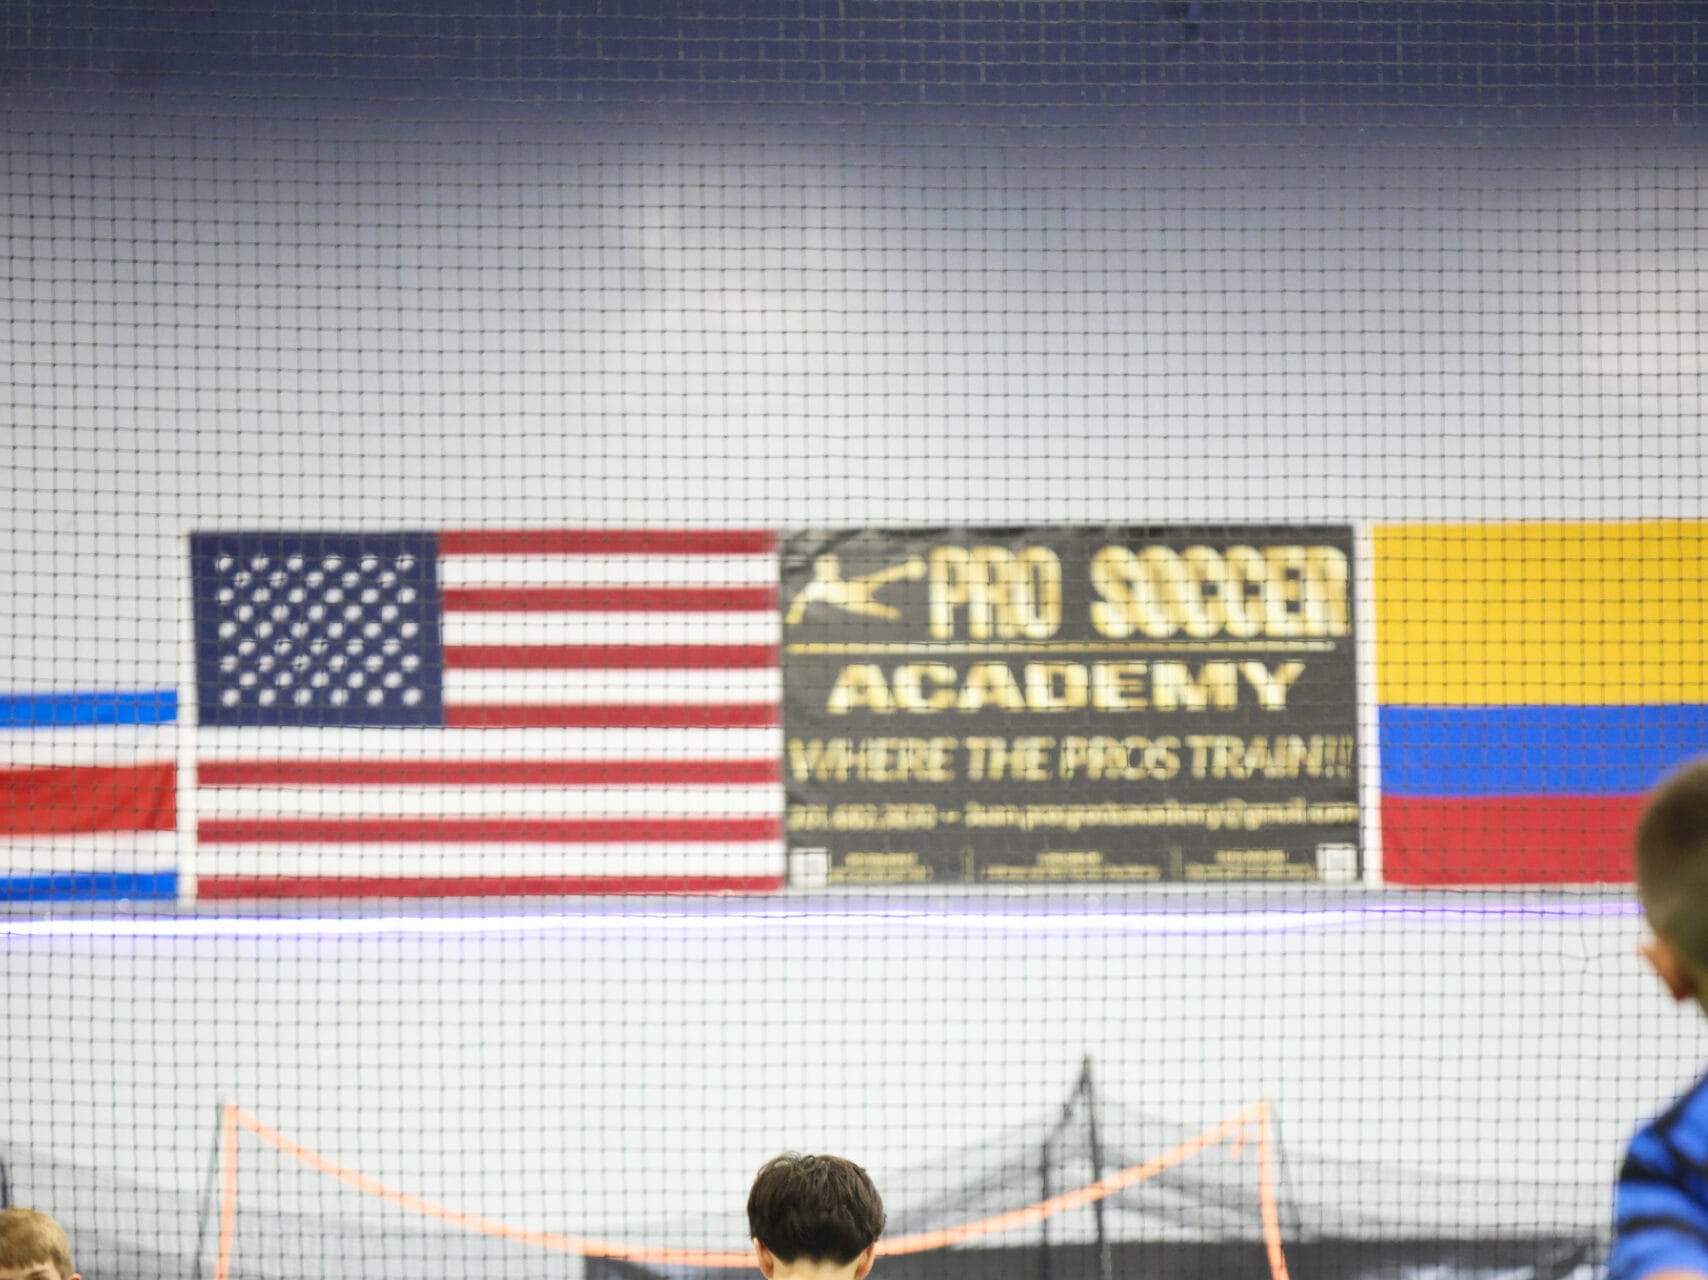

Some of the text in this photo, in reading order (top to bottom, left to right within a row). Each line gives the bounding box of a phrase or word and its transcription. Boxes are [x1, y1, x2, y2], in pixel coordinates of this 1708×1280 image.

[928, 543, 1352, 640] PRO SOCCER
[827, 658, 1307, 714] ACADEMY
[787, 735, 957, 783] WHERE
[963, 735, 1056, 782] THE
[1059, 734, 1182, 782] PROS
